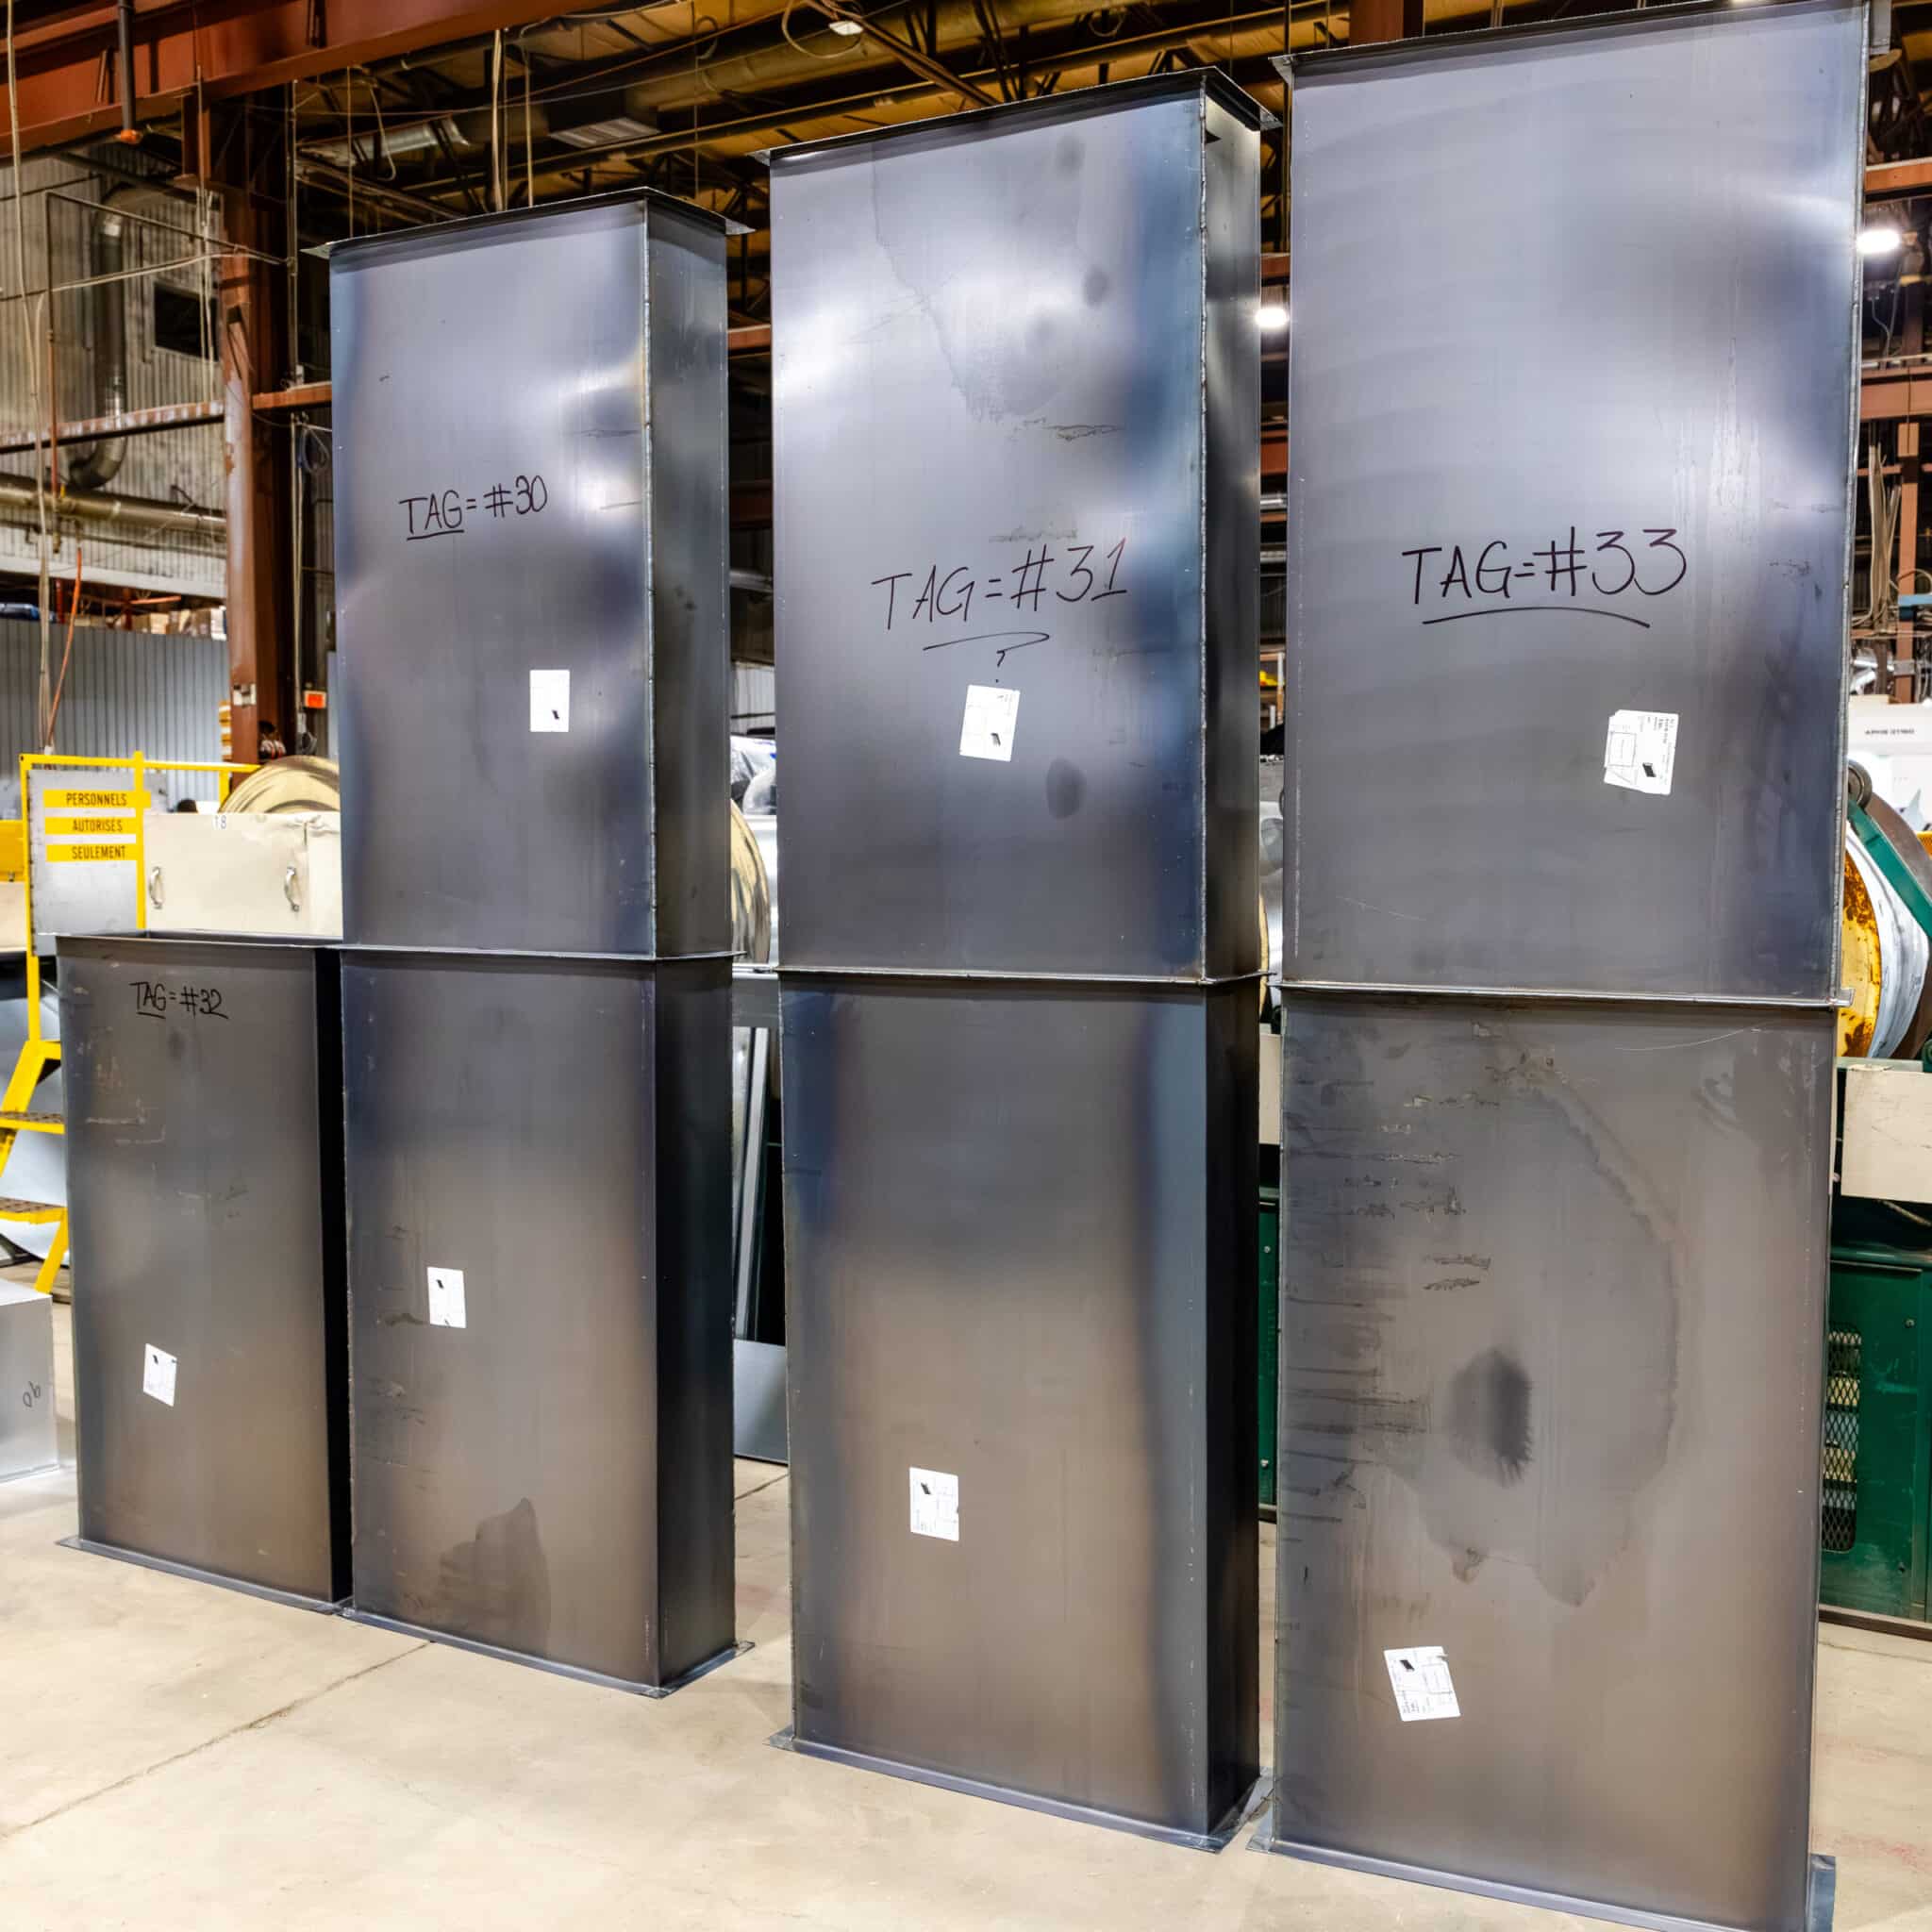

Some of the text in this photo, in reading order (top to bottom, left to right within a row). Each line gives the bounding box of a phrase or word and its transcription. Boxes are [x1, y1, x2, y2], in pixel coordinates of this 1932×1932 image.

[398, 475, 548, 537] TAG=#30
[871, 537, 1128, 630] TAG=#31
[1402, 525, 1687, 605] TAG=#33
[66, 792, 127, 807] PERSONNELS
[72, 845, 125, 859] SEULEMENT
[128, 981, 229, 1020] TAG=#32
